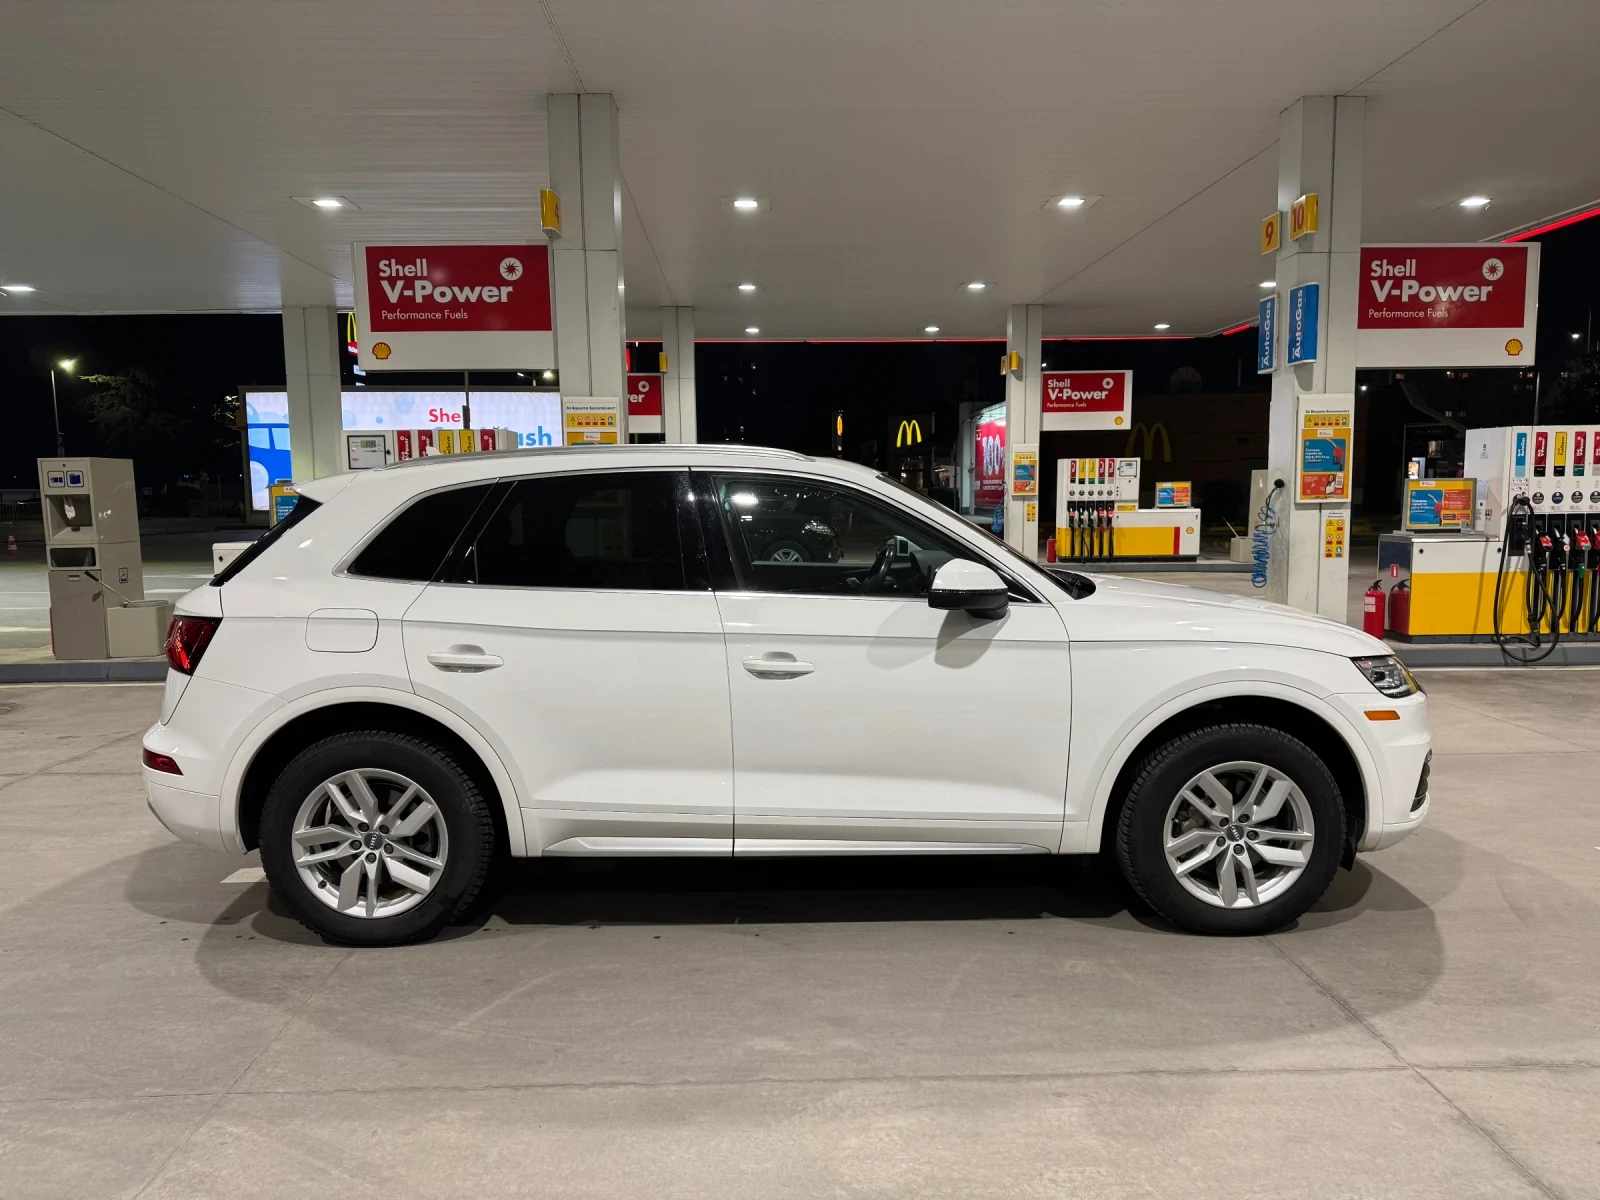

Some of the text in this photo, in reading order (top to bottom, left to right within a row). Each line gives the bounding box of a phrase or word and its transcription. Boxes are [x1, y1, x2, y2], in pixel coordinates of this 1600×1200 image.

[1292, 203, 1305, 233] 10
[1265, 221, 1274, 247] 9
[378, 258, 428, 278] Shell
[1370, 258, 1416, 277] Shell
[380, 280, 514, 304] V-Power
[1370, 279, 1493, 303] V-Power
[381, 308, 468, 321] Performance Fuels
[1368, 306, 1449, 319] Performance Fuels
[1263, 301, 1272, 367] AutoGas
[1294, 289, 1303, 359] AutoGas
[1047, 379, 1070, 388] Shell
[1048, 388, 1109, 401] V-Power
[429, 407, 471, 423] She
